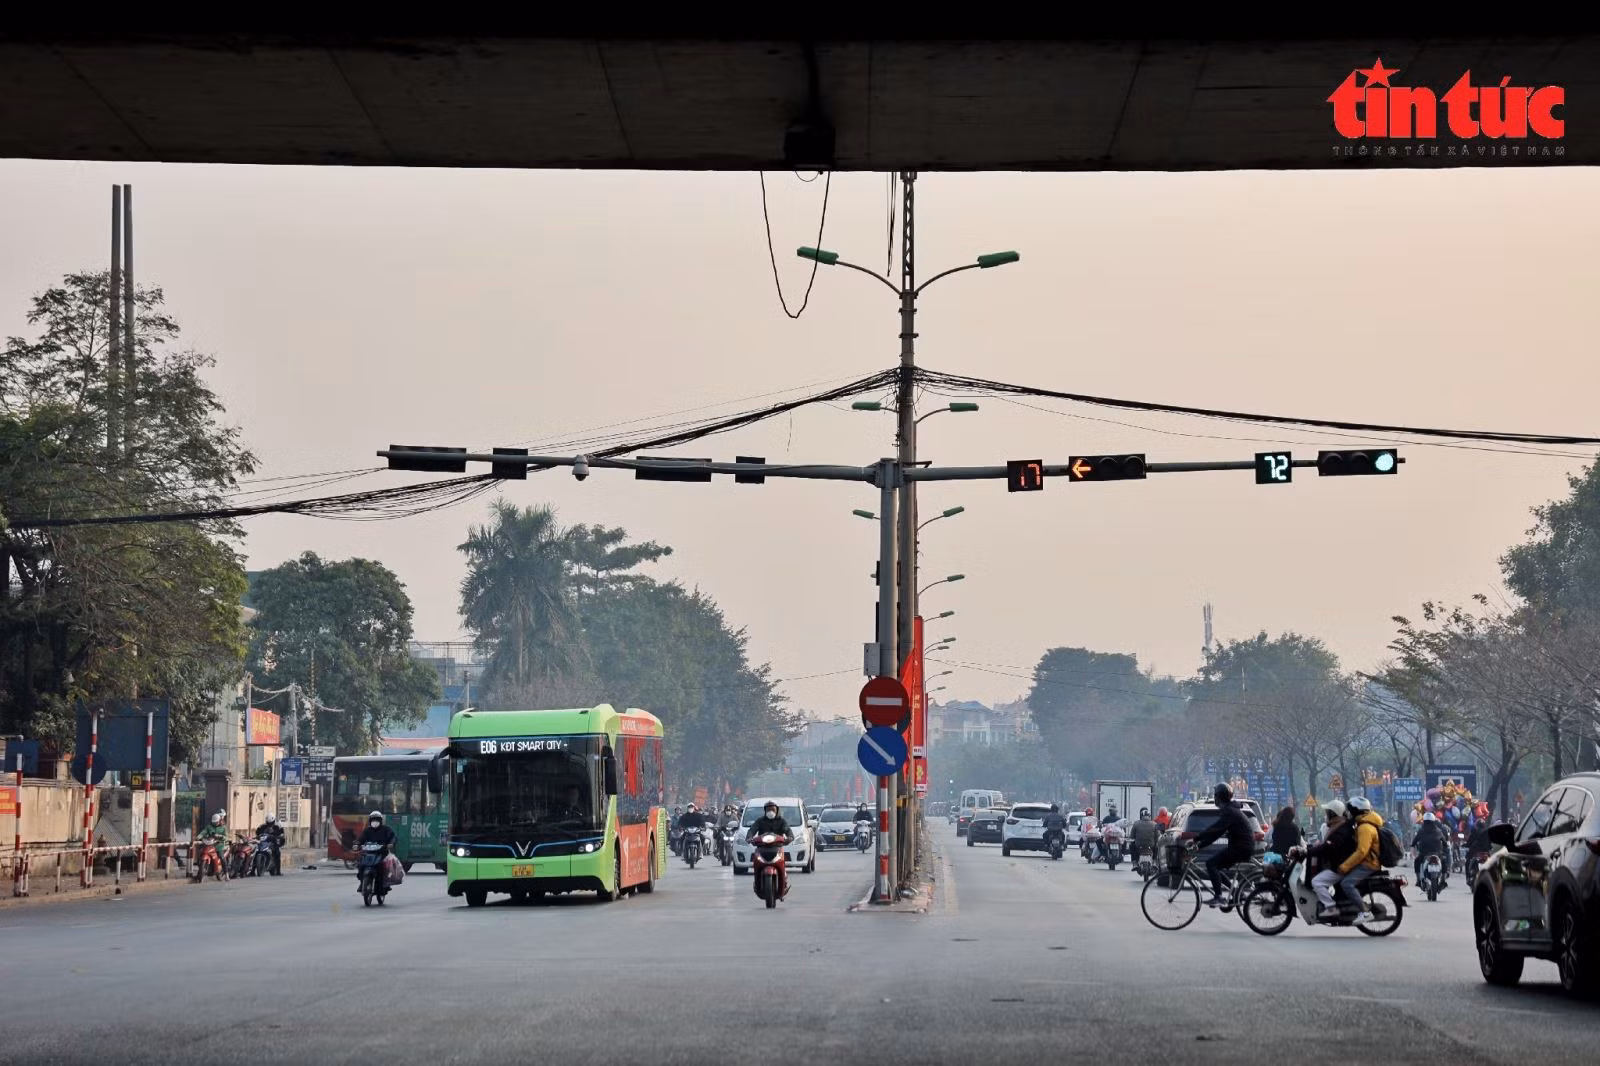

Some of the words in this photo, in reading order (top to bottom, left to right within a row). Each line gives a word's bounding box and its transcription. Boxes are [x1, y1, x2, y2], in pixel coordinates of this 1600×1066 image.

[1020, 463, 1041, 487] 17
[1264, 455, 1289, 480] 72
[480, 740, 497, 754] E06
[500, 741, 515, 752] KĐT
[517, 741, 544, 752] SMART
[546, 740, 562, 750] CITY
